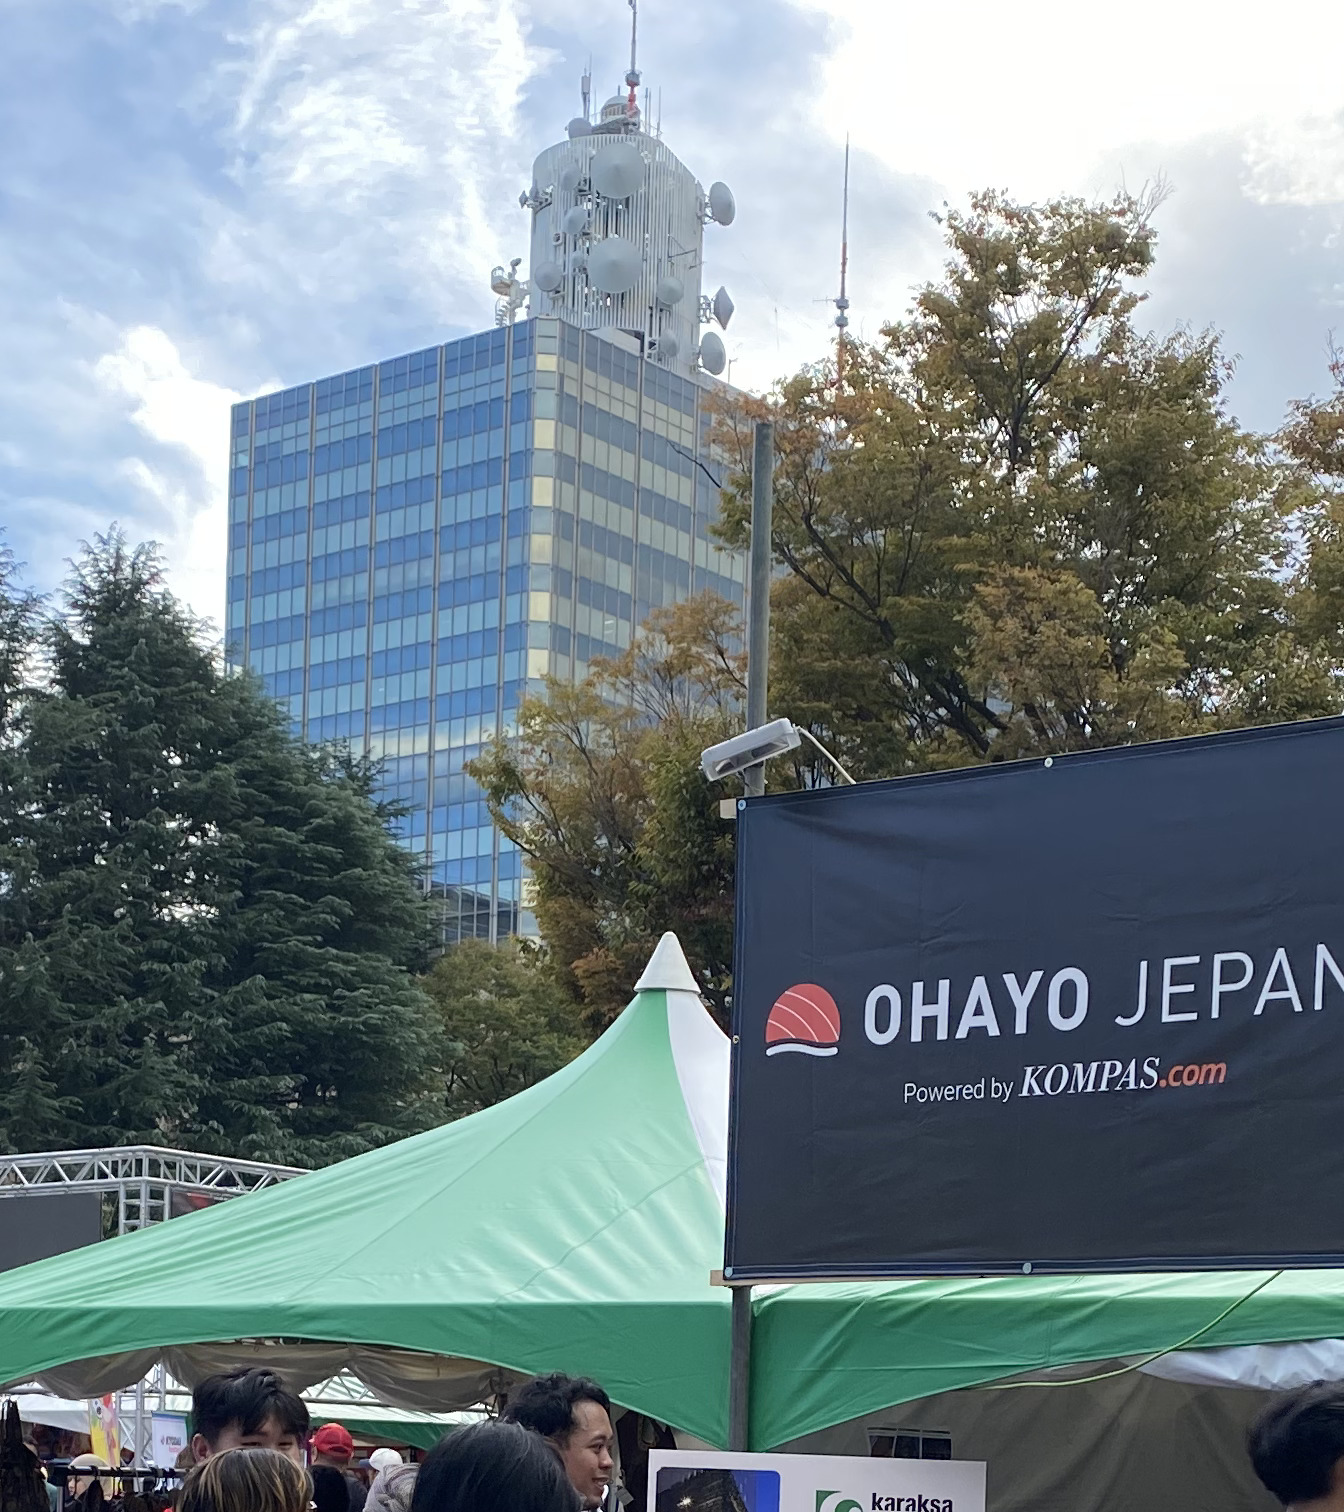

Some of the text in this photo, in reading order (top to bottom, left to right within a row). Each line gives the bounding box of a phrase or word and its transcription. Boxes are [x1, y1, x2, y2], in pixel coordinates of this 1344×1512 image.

[864, 967, 1089, 1045] OHAYO
[904, 1057, 1227, 1104] Powered by KOMPAS.com
[871, 1492, 953, 1512] karaksa
